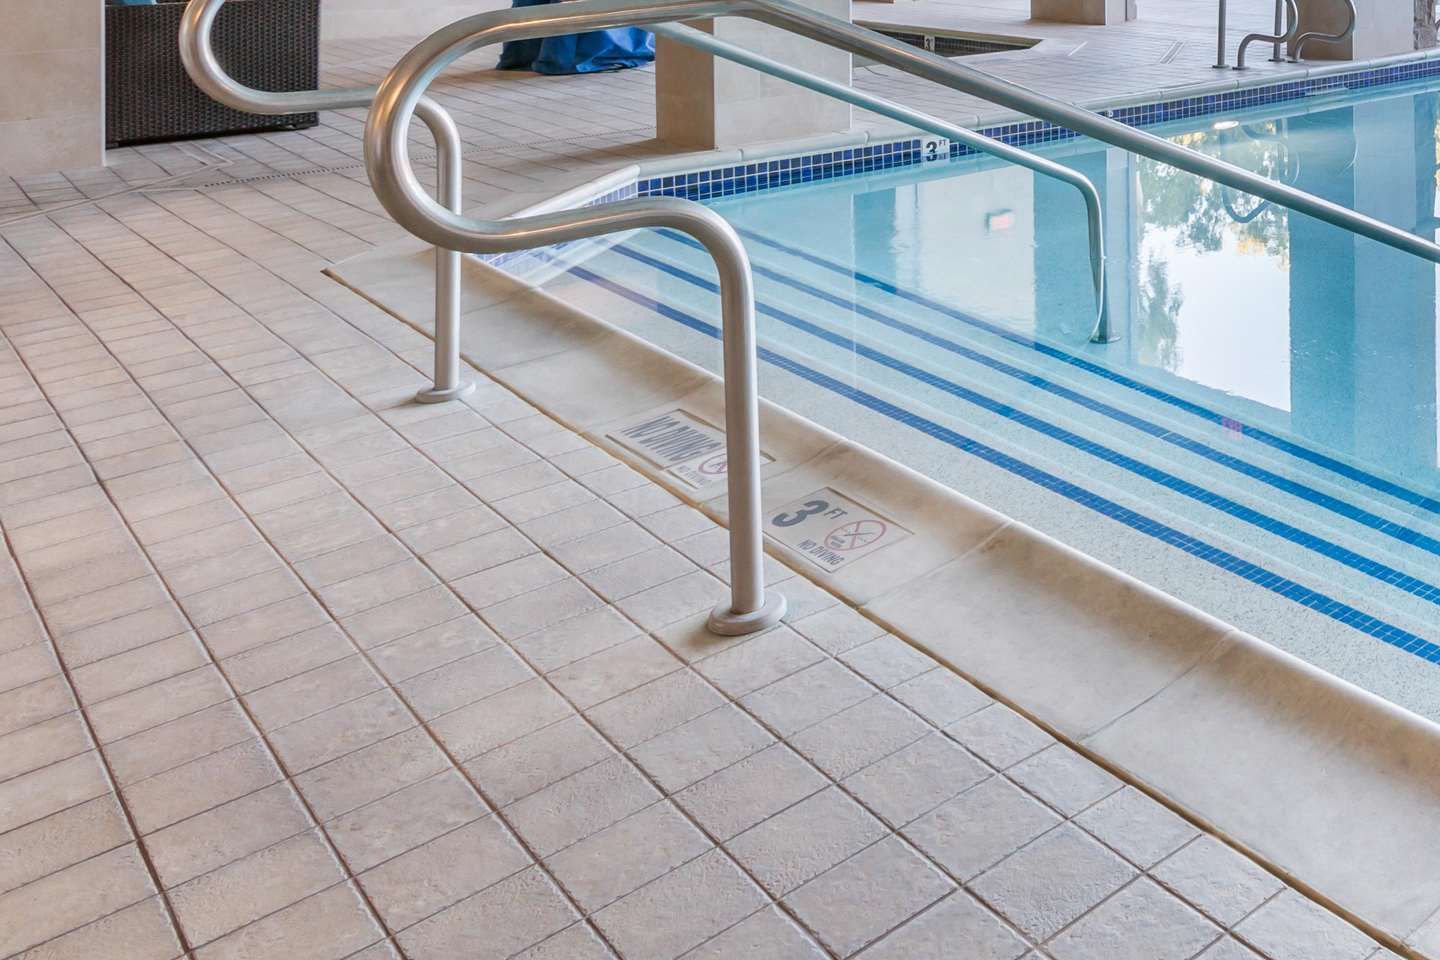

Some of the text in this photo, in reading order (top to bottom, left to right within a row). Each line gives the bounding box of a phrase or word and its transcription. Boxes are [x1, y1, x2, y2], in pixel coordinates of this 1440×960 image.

[926, 141, 937, 161] 3
[620, 415, 722, 461] NO DIVING
[771, 500, 849, 528] 3 FT
[798, 538, 818, 551] NO
[809, 545, 846, 566] DIVING
